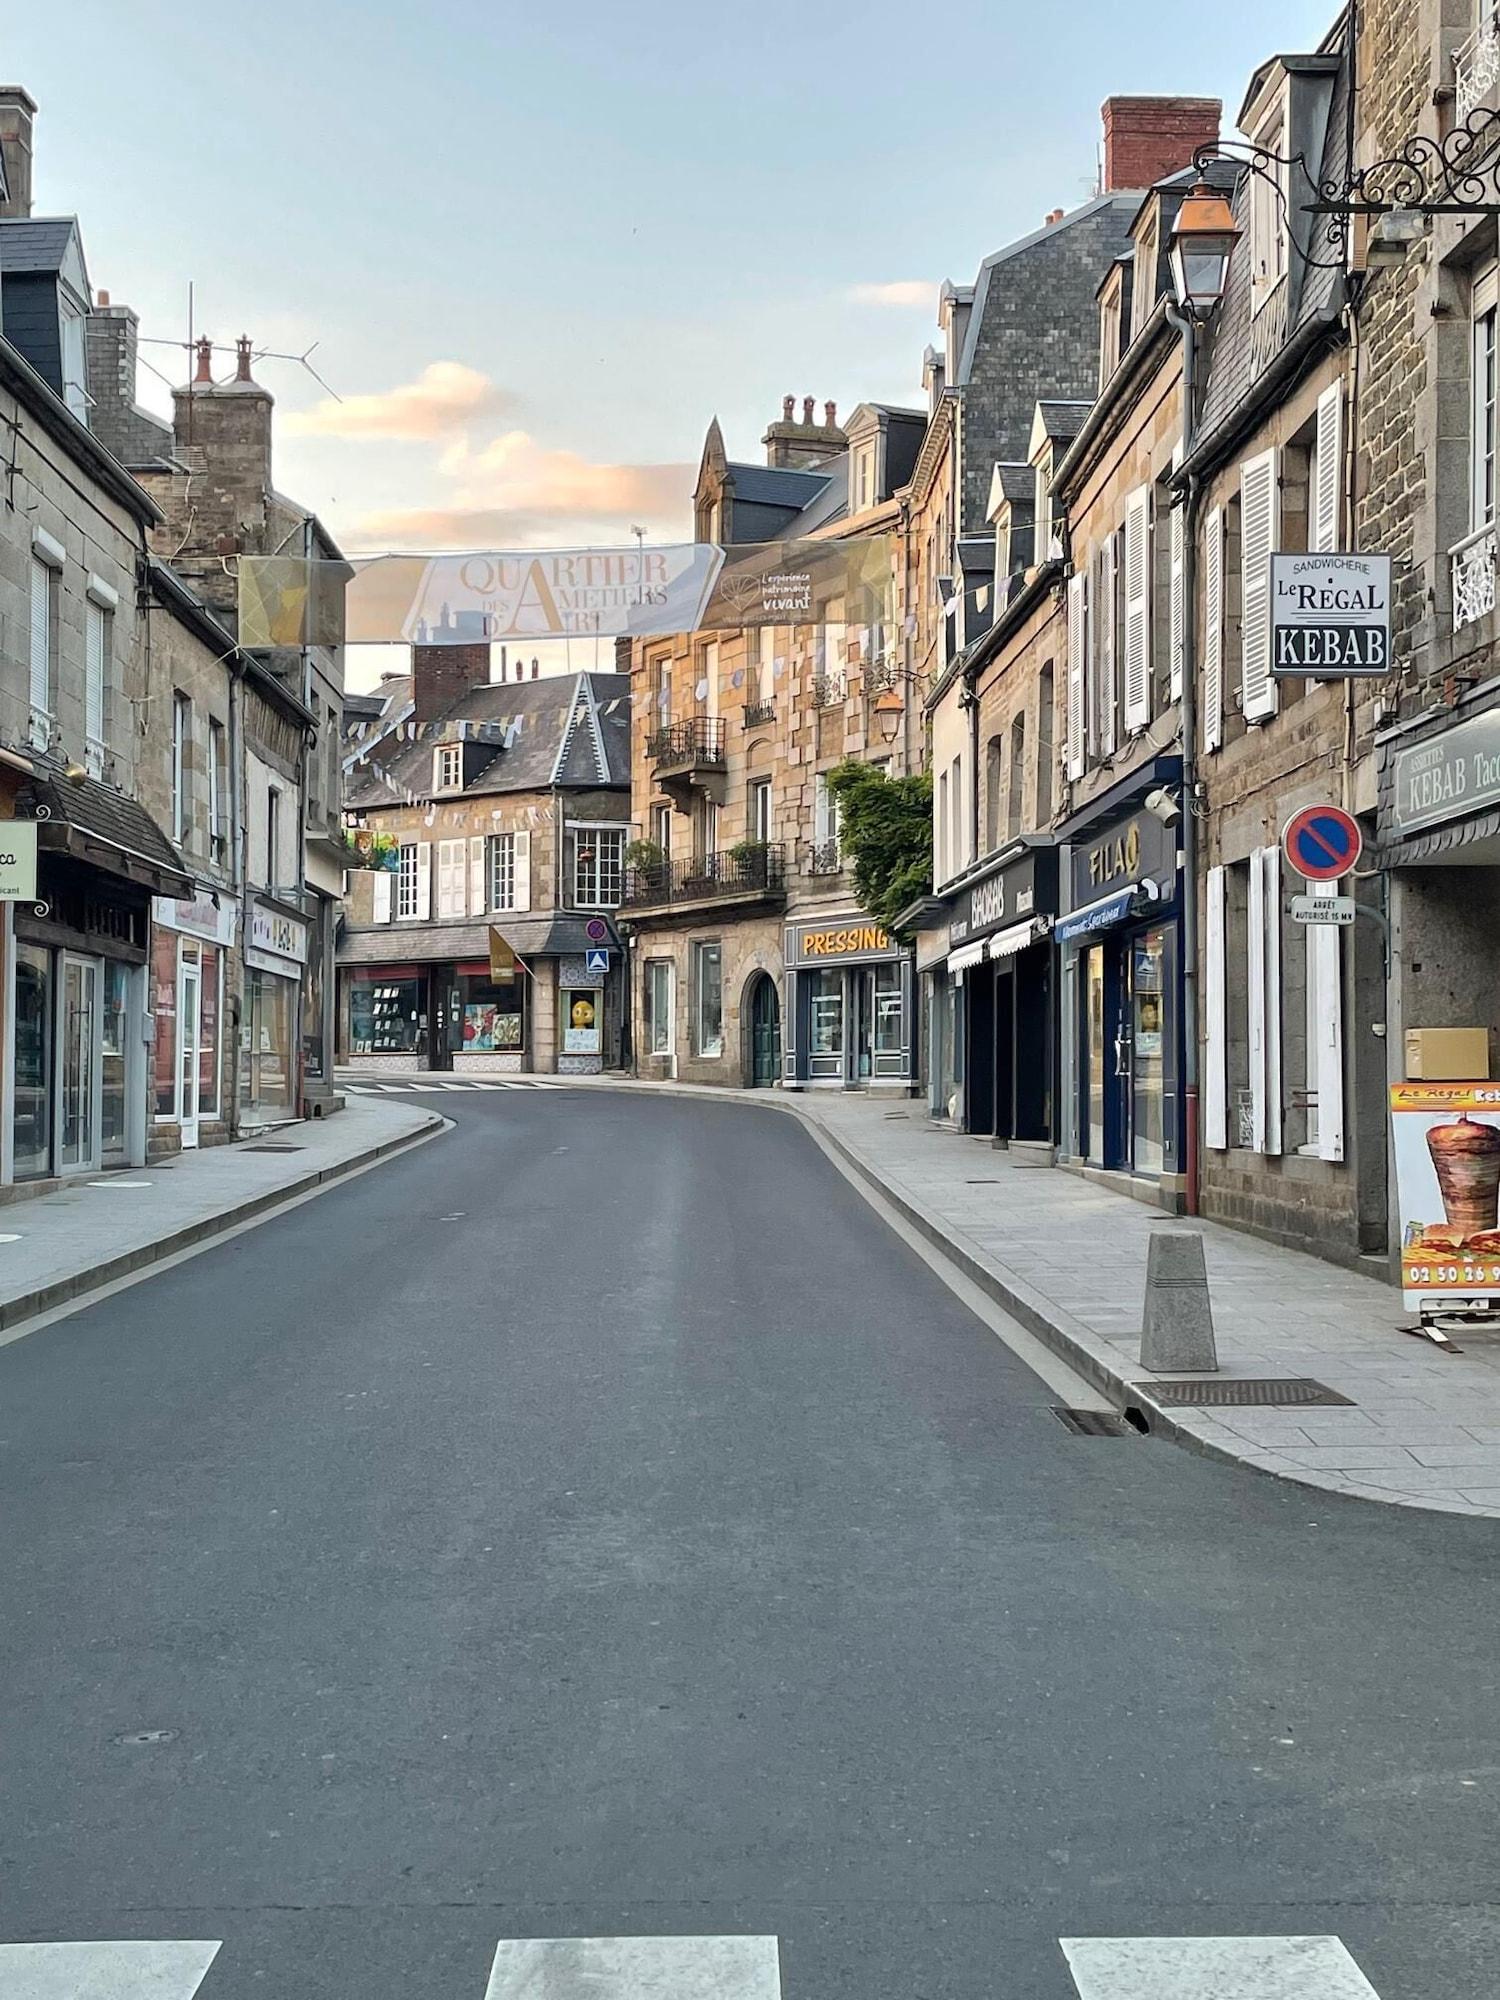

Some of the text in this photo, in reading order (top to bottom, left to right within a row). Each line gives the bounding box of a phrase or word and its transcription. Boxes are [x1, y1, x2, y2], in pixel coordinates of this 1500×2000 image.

[1292, 558, 1371, 576] SANDWICHERIE
[761, 583, 811, 597] patrimoine
[1278, 580, 1297, 596] Le
[761, 591, 812, 611] vivant
[1278, 628, 1385, 665] KEBAB
[1409, 757, 1467, 812] KEBAB
[1088, 821, 1140, 887] FILAO
[971, 874, 1005, 930] BAOBAB
[803, 927, 890, 956] PRESSING
[1410, 1266, 1430, 1283] 02
[1464, 1266, 1486, 1283] 26
